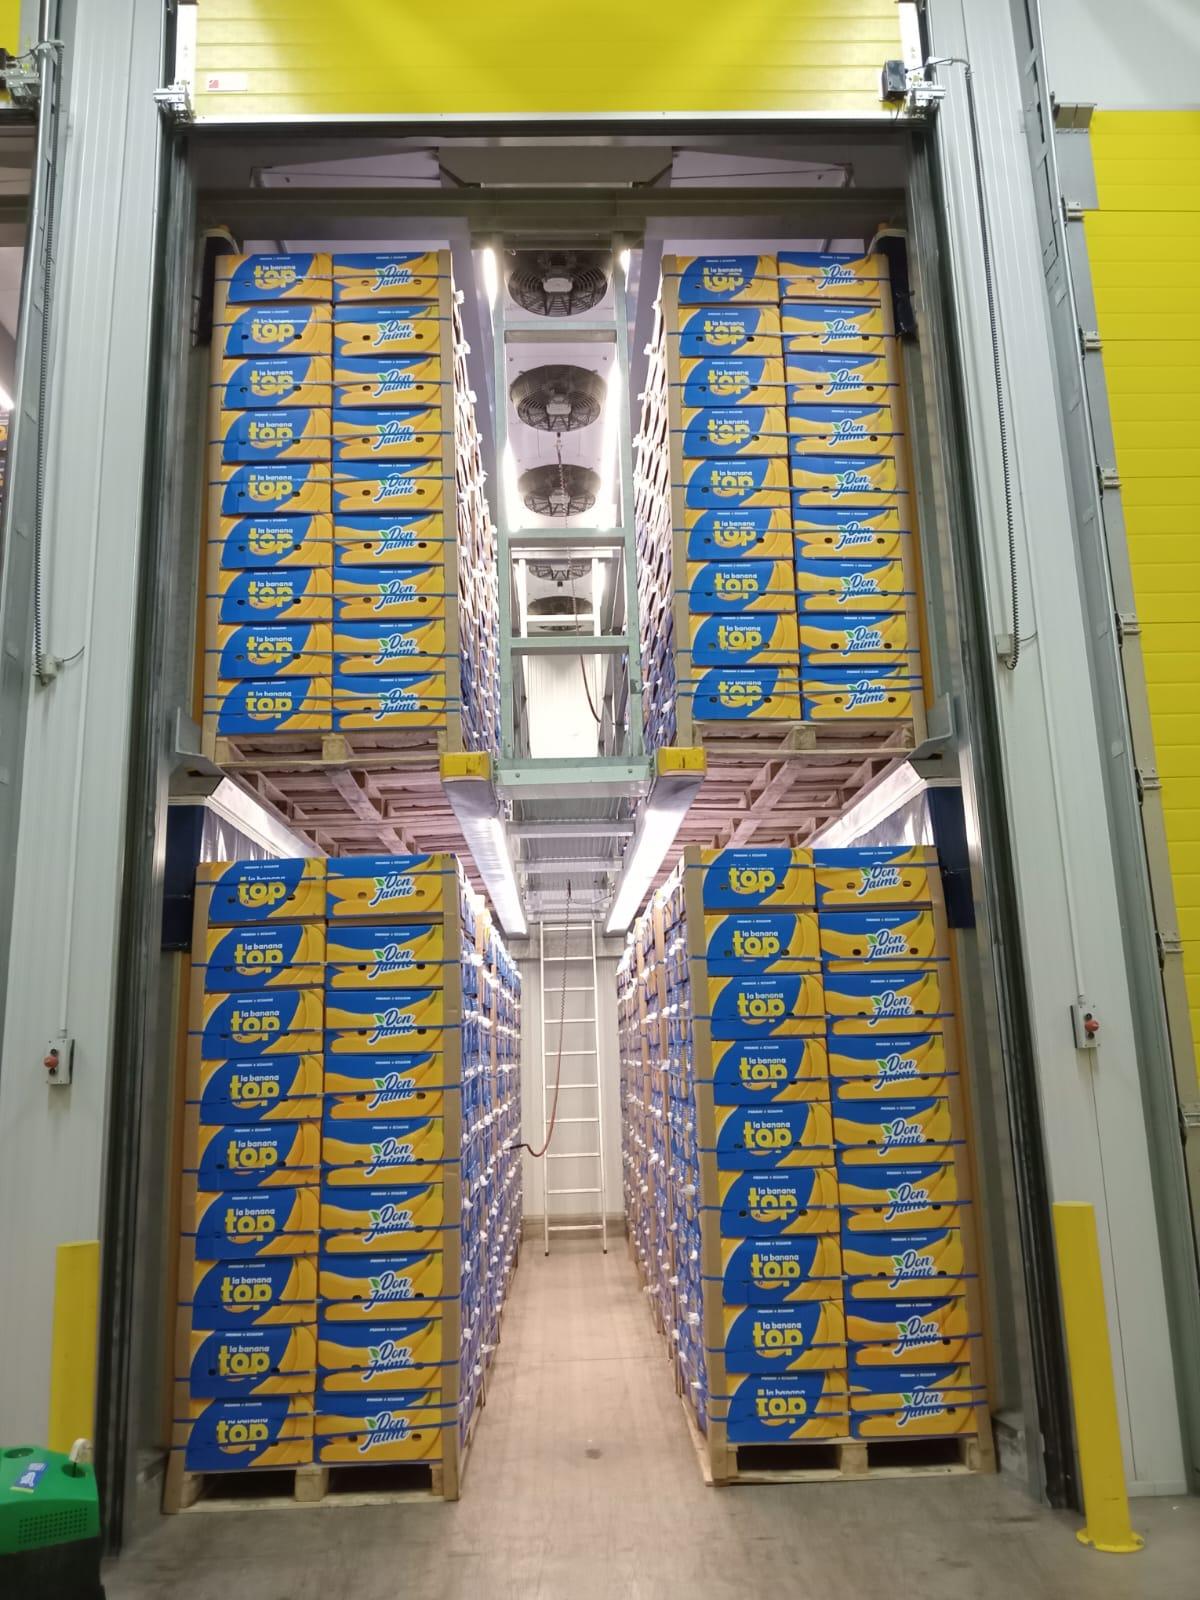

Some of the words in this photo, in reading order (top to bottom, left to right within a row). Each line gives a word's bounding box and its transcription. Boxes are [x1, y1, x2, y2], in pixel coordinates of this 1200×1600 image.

[254, 266, 297, 288] top
[385, 266, 407, 277] Don
[703, 268, 743, 290] top
[829, 265, 851, 276] Don
[250, 319, 295, 342] top
[386, 321, 408, 332] Don
[703, 321, 745, 344] top
[834, 318, 855, 331] Don
[376, 332, 410, 345] Jaime
[249, 371, 294, 395] top
[387, 370, 411, 382] Don
[708, 370, 751, 394] top
[838, 368, 859, 381] Don
[386, 422, 410, 434] Don
[707, 420, 751, 443] top
[842, 418, 863, 431] Don
[248, 422, 293, 447] top
[387, 473, 411, 486] Don
[711, 471, 754, 495] top
[845, 471, 866, 484] Don
[247, 475, 292, 500] top
[375, 487, 412, 501] Jaime
[389, 526, 412, 539] Don
[713, 521, 756, 546] top
[847, 522, 871, 534] Don
[248, 528, 292, 553] top
[835, 535, 872, 549] Jaime
[389, 580, 410, 592] Don
[715, 573, 758, 599] top
[852, 574, 873, 587] Don
[248, 582, 293, 607] top
[389, 634, 412, 647] Don
[718, 626, 762, 650] top
[854, 627, 879, 640] Don
[248, 637, 292, 663] top
[390, 688, 413, 702] Don
[719, 682, 762, 706] top
[857, 681, 882, 694] Don
[246, 692, 292, 718] top
[845, 694, 884, 708] Jaime
[871, 862, 896, 877] Don
[385, 872, 410, 887] Don
[730, 868, 775, 892] top
[856, 877, 898, 895] Jaime
[238, 878, 286, 904] top
[370, 887, 412, 905] Jaime
[732, 931, 779, 957] top
[876, 931, 902, 944] Don
[235, 945, 282, 972] top
[384, 944, 409, 959] Don
[738, 994, 785, 1022] top
[882, 992, 907, 1007] Don
[385, 1009, 410, 1024] Don
[232, 1012, 280, 1040] top
[749, 1058, 756, 1066] la
[888, 1054, 913, 1069] Don
[384, 1073, 411, 1088] Don
[739, 1058, 787, 1088] top
[230, 1076, 279, 1105] top
[892, 1119, 919, 1135] Don
[744, 1122, 791, 1152] top
[382, 1139, 409, 1155] Don
[228, 1142, 277, 1172] top
[758, 1188, 765, 1197] la
[899, 1184, 924, 1199] Don
[750, 1188, 797, 1219] top
[380, 1206, 407, 1221] Don
[226, 1209, 275, 1240] top
[902, 1251, 930, 1268] Don
[752, 1255, 800, 1286] top
[379, 1272, 408, 1289] Don
[222, 1278, 272, 1309] top
[908, 1317, 935, 1332] Don
[754, 1323, 802, 1355] top
[380, 1342, 407, 1359] Don
[220, 1347, 269, 1378] top
[912, 1387, 939, 1402] Don
[757, 1390, 806, 1423] top
[376, 1412, 404, 1429] Don
[218, 1421, 267, 1450] top
